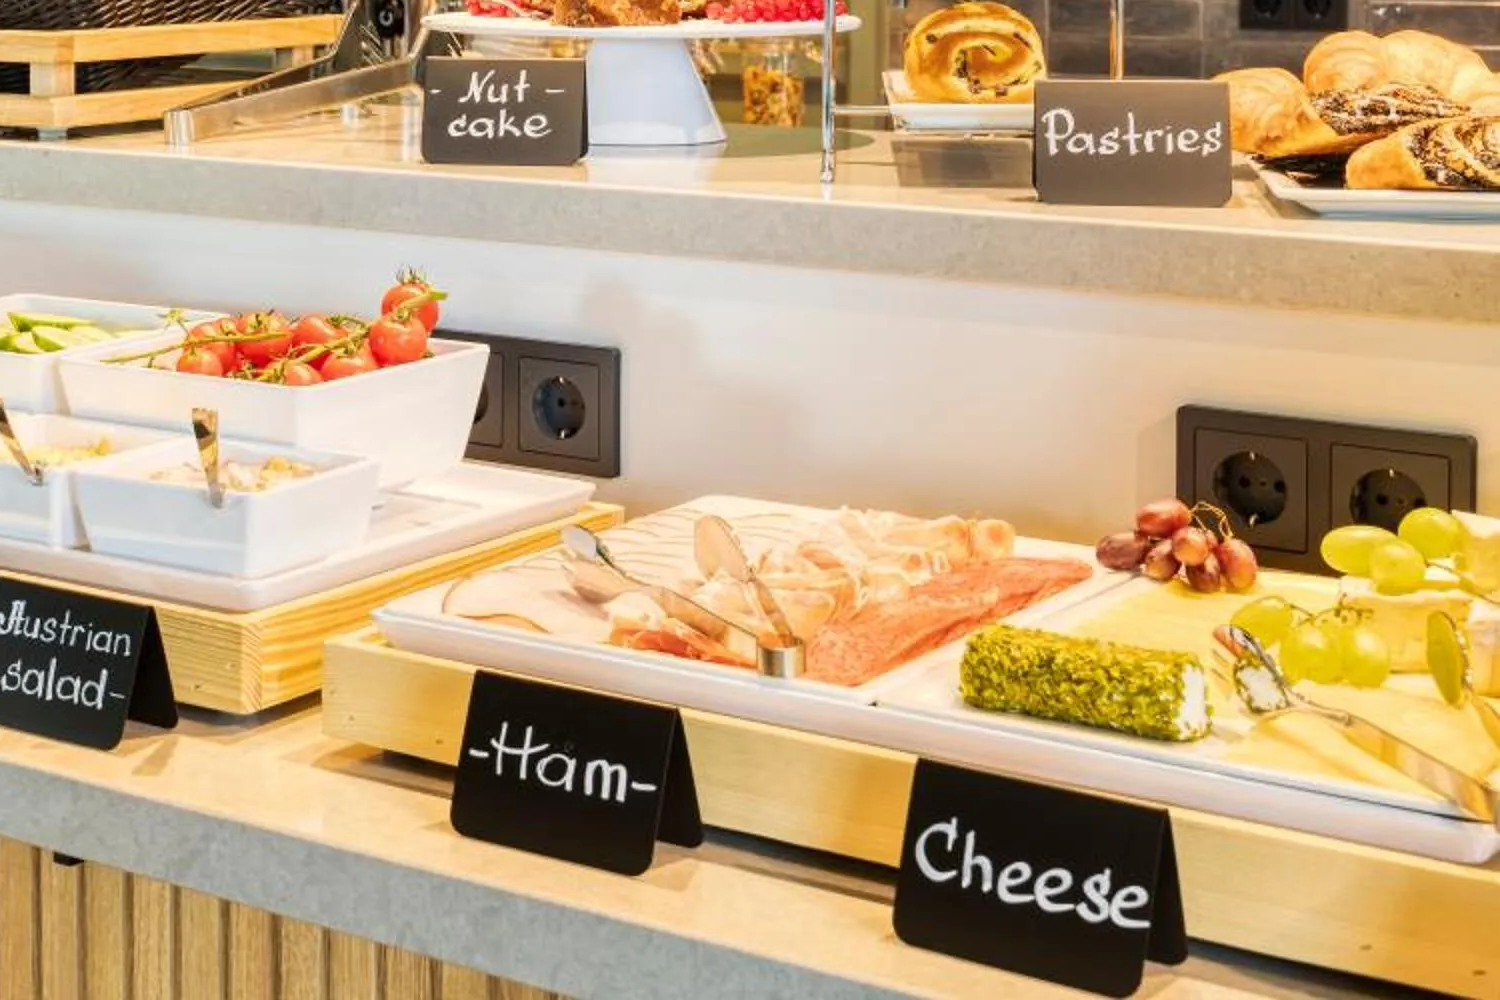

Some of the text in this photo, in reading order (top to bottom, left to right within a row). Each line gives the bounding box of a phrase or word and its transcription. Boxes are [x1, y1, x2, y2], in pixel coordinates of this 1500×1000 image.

[458, 69, 531, 104] Nut
[447, 108, 553, 140] cake
[1040, 107, 1223, 157] Pastries
[914, 816, 1152, 930] Cheese
